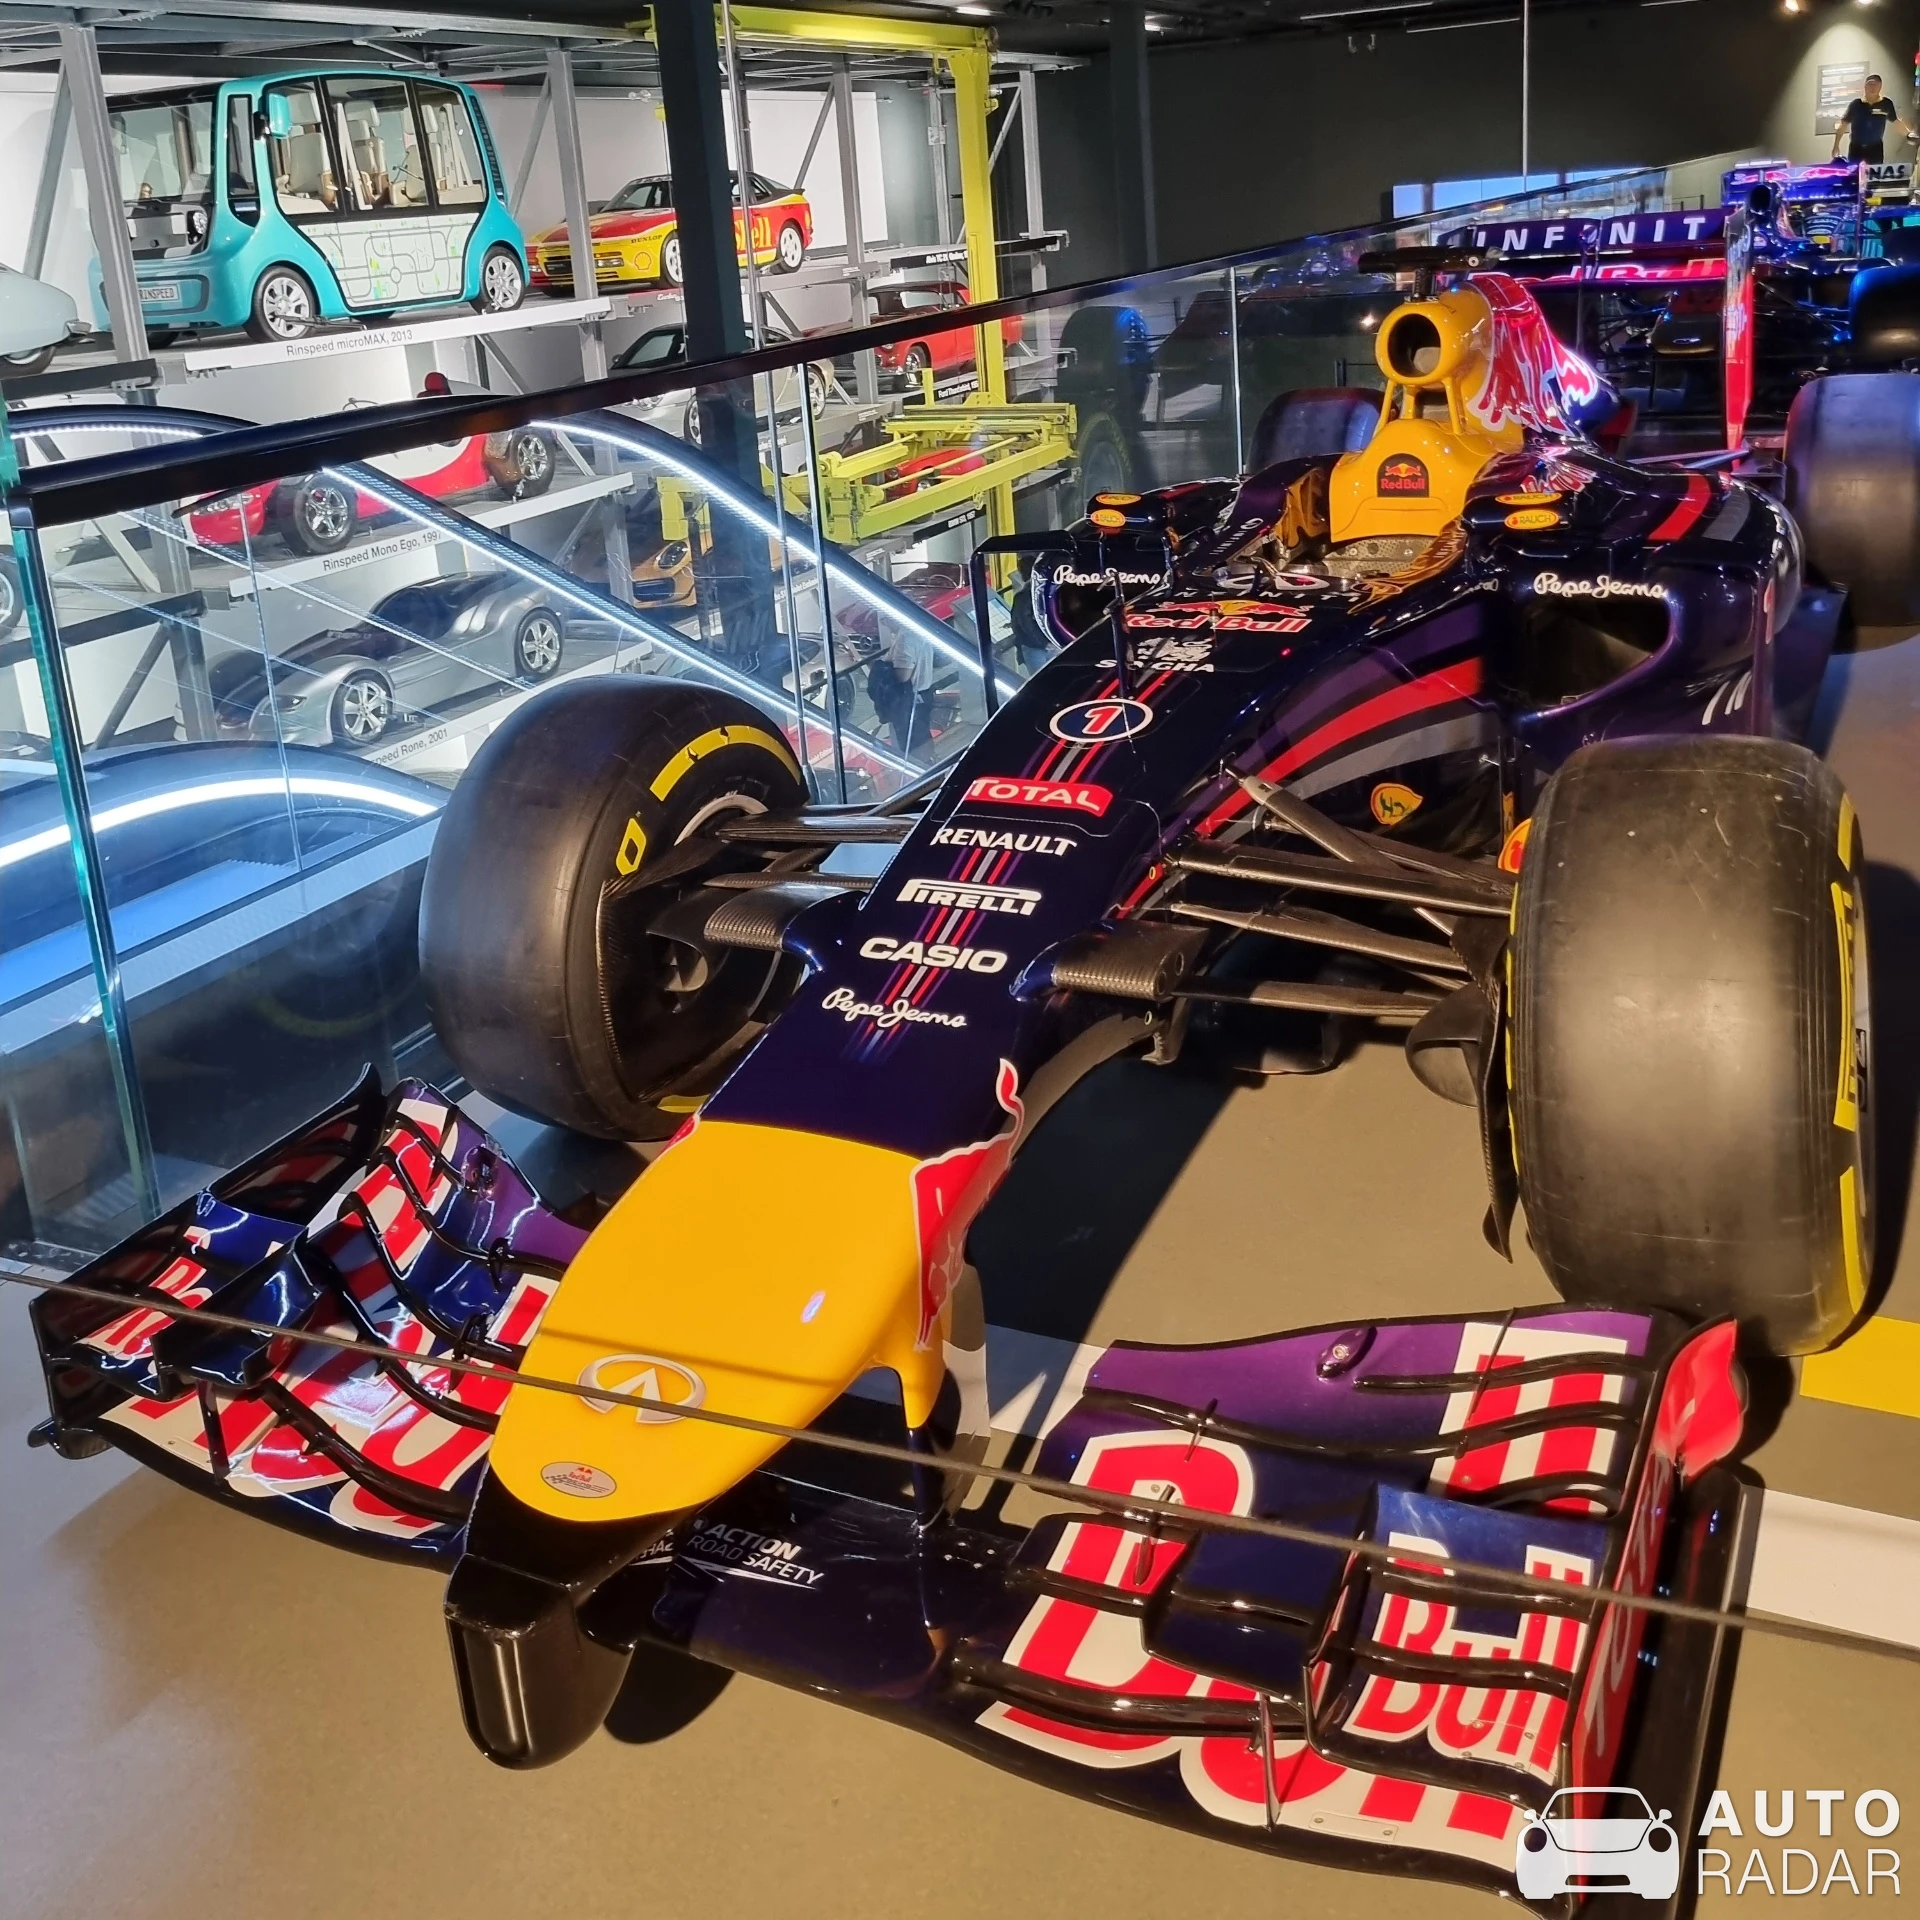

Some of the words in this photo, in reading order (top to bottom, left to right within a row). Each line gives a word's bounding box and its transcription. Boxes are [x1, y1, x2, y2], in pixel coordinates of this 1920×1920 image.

[631, 234, 662, 244] DUNLOP
[286, 340, 334, 356] Rinspeed
[336, 333, 389, 350] microMAX,
[391, 329, 413, 342] 2013
[1381, 478, 1403, 489] Red
[1404, 478, 1425, 489] Bull
[1519, 513, 1551, 524] RAUCH
[323, 549, 369, 572] Rinspeed
[371, 544, 398, 559] Mono
[400, 538, 421, 552] Ego,
[1053, 564, 1104, 586] Pepe
[1533, 572, 1592, 597] Pepe
[1592, 575, 1667, 599] Jeans
[1127, 614, 1208, 629] Red
[1211, 616, 1313, 633] Bull
[1095, 659, 1215, 673] SGHA
[1082, 706, 1123, 735] 1
[401, 740, 427, 756] Rone,
[428, 728, 448, 744] 2001
[970, 779, 1101, 812] TOTAL
[930, 828, 1078, 856] RENAULT
[895, 878, 1042, 916] PIRELLI
[859, 937, 1008, 974] CASIO
[821, 987, 883, 1022] Pepe
[878, 999, 967, 1028] Jeans
[704, 1524, 801, 1560] ACTION
[687, 1535, 743, 1560] ROAD
[742, 1552, 824, 1584] SAFETY
